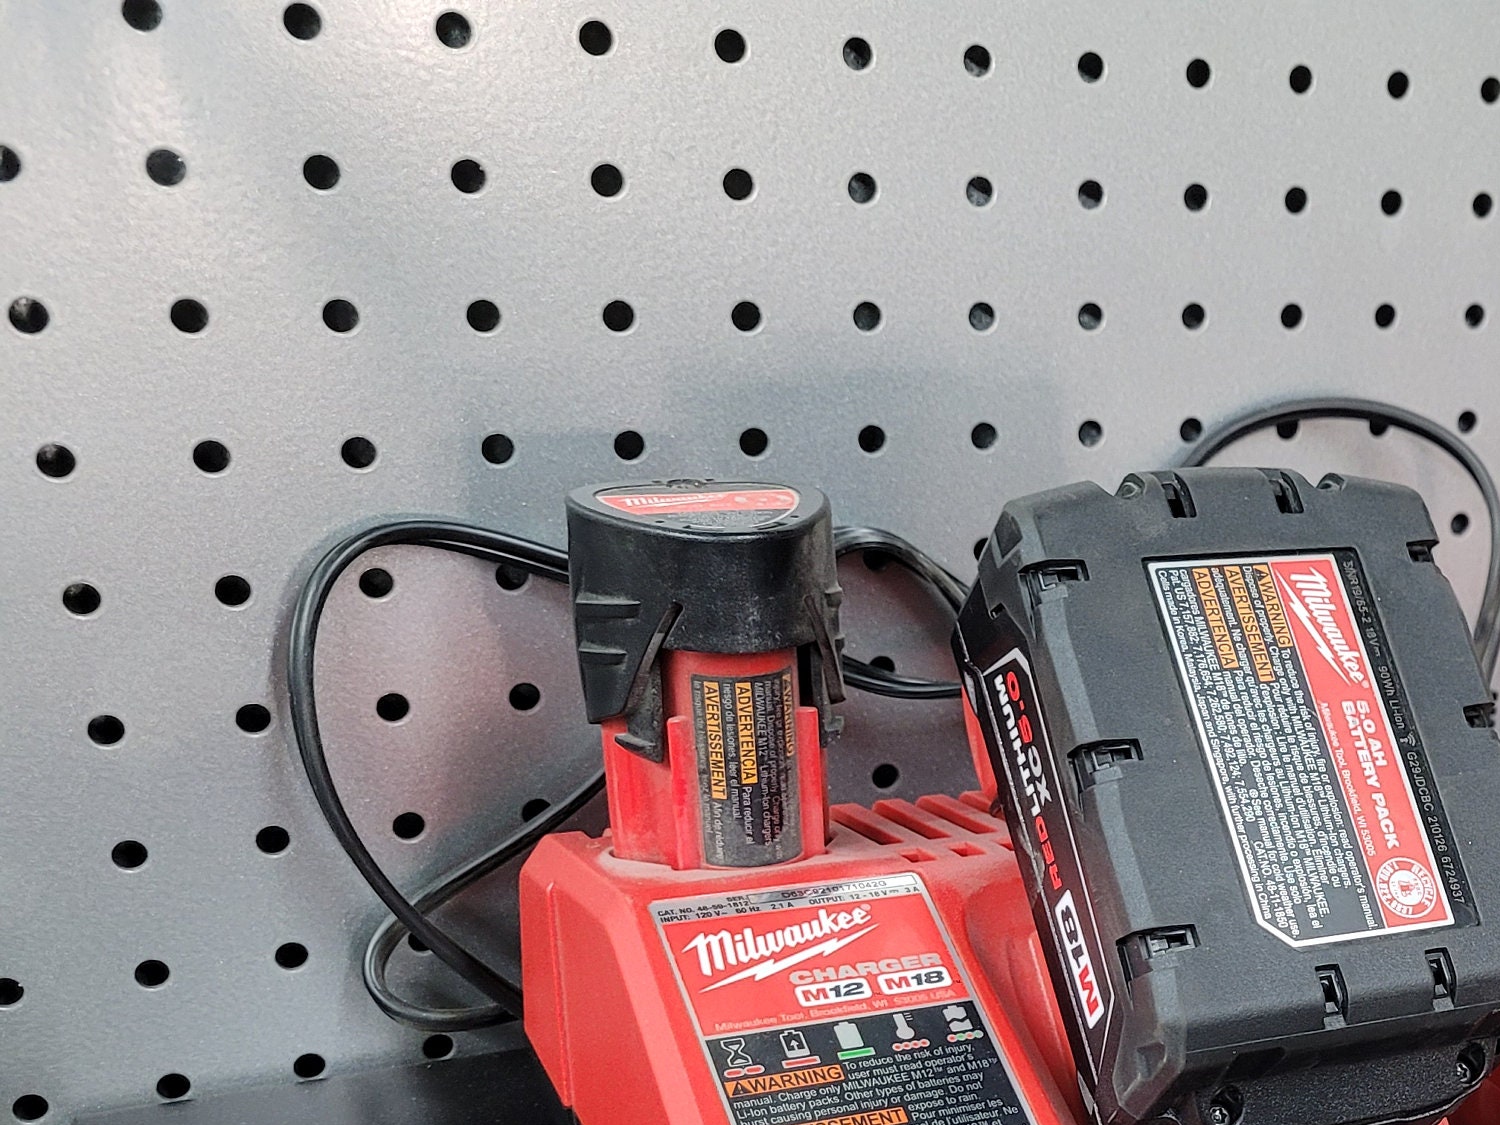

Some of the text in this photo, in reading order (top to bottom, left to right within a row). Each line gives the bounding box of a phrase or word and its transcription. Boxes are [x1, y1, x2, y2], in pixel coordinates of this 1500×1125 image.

[1240, 566, 1261, 598] Dispose
[1193, 570, 1237, 666] ADVERTENCIA
[1253, 599, 1264, 608] of
[1258, 580, 1291, 645] WARNING
[1225, 568, 1273, 679] AVERTISSEMENT
[1289, 567, 1367, 688] Milwaukee
[1265, 645, 1286, 676] Charge
[1280, 649, 1292, 659] To
[1275, 677, 1292, 696] only
[1283, 660, 1301, 688] reduce
[1283, 696, 1298, 714] with
[1293, 689, 1306, 704] the
[1298, 705, 1312, 720] risk
[705, 686, 726, 797] AVERTISSEMENT
[737, 686, 756, 781] ADVERTENCIA
[1007, 670, 1052, 809] XC5.0
[1303, 721, 1315, 730] of
[1354, 699, 1388, 766] 5.0 AH
[1290, 715, 1316, 771] MILWAUKEE
[1314, 758, 1328, 772] fire
[1319, 773, 1329, 783] or
[1340, 700, 1400, 850] BATTERY PACK
[742, 787, 751, 806] Para
[994, 673, 1063, 891] REDLITHIUM
[1320, 784, 1345, 827] explosion:
[1316, 799, 1340, 846] Lithium-Ion
[1337, 828, 1352, 849] read
[1359, 829, 1376, 856] 53005
[1341, 850, 1366, 894] operator's
[1439, 855, 1465, 903] 6724937
[681, 908, 870, 976] Milwaukee
[788, 953, 942, 985] CHARGER
[1060, 904, 1099, 1018] M18
[801, 970, 944, 1004] M12 M18
[843, 1060, 857, 1069] To
[857, 1054, 894, 1067] reduce
[894, 1052, 912, 1062] the
[912, 1049, 932, 1059] risk
[932, 1047, 944, 1056] of
[847, 1052, 975, 1079] user must read operator's
[735, 1105, 768, 1119] Li-Ion
[768, 1099, 808, 1116] battery
[843, 1088, 875, 1101] Other
[874, 1084, 905, 1098] types
[904, 1082, 916, 1091] of
[916, 1074, 961, 1089] batteries
[962, 1072, 986, 1084] may
[747, 1066, 843, 1093] WARNING
[776, 1086, 818, 1104] Charge
[817, 1082, 843, 1097] only
[841, 1071, 910, 1091] MILWAUKEE
[945, 1062, 966, 1073] and
[768, 1109, 813, 1125] causing
[812, 1101, 860, 1119] personal
[859, 1096, 890, 1111] injury
[889, 1096, 902, 1104] or
[948, 1083, 965, 1094] Do
[964, 1081, 982, 1091] not
[907, 1099, 945, 1113] expose
[945, 1096, 957, 1105] to
[910, 1097, 1004, 1121] Pour minimiser les
